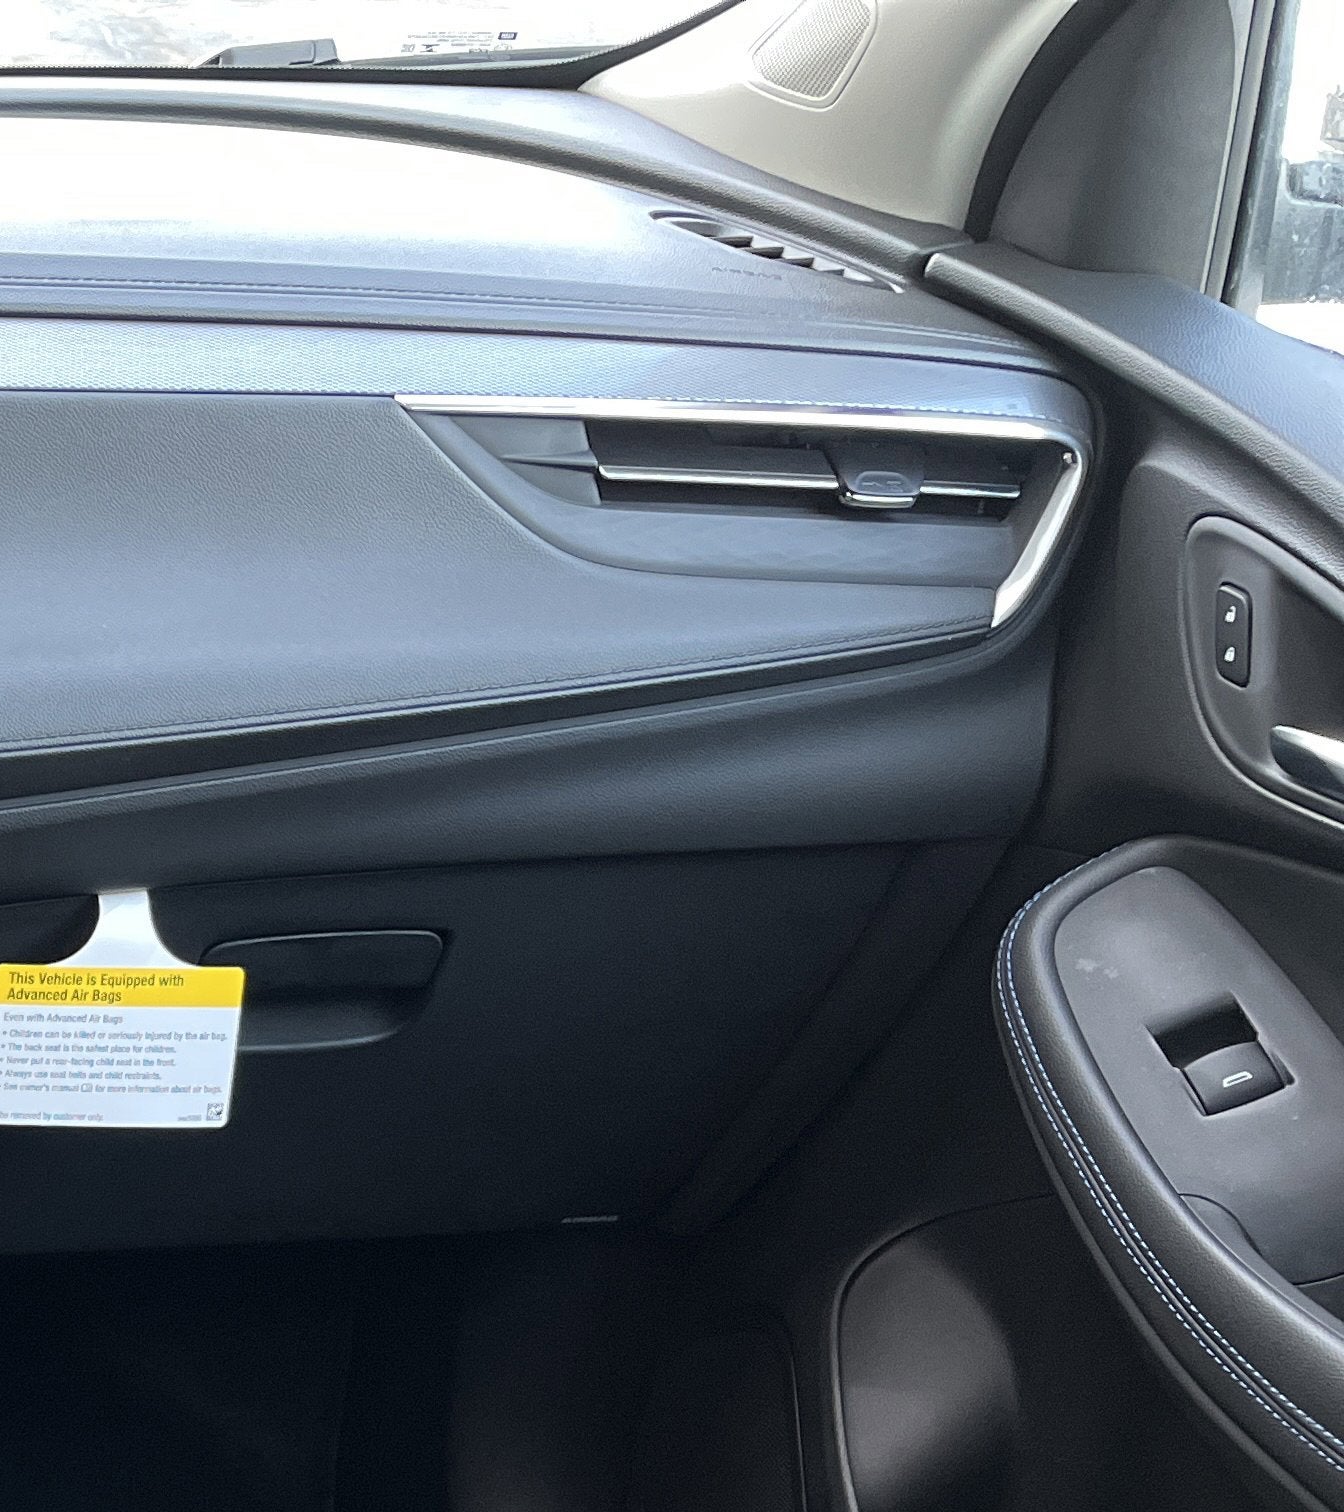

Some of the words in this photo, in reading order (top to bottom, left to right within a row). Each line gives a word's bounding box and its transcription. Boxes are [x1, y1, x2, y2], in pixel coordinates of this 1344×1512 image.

[9, 971, 34, 985] This
[39, 972, 82, 986] Vehicle
[87, 973, 96, 985] is
[101, 974, 155, 988] Equipped
[159, 974, 184, 987] with
[7, 988, 67, 1001] Advanced
[71, 989, 89, 1001] Air
[93, 990, 122, 1004] Bags
[3, 1012, 24, 1022] Even
[27, 1013, 44, 1022] with
[47, 1013, 87, 1023] Advanced
[89, 1014, 101, 1023] Air
